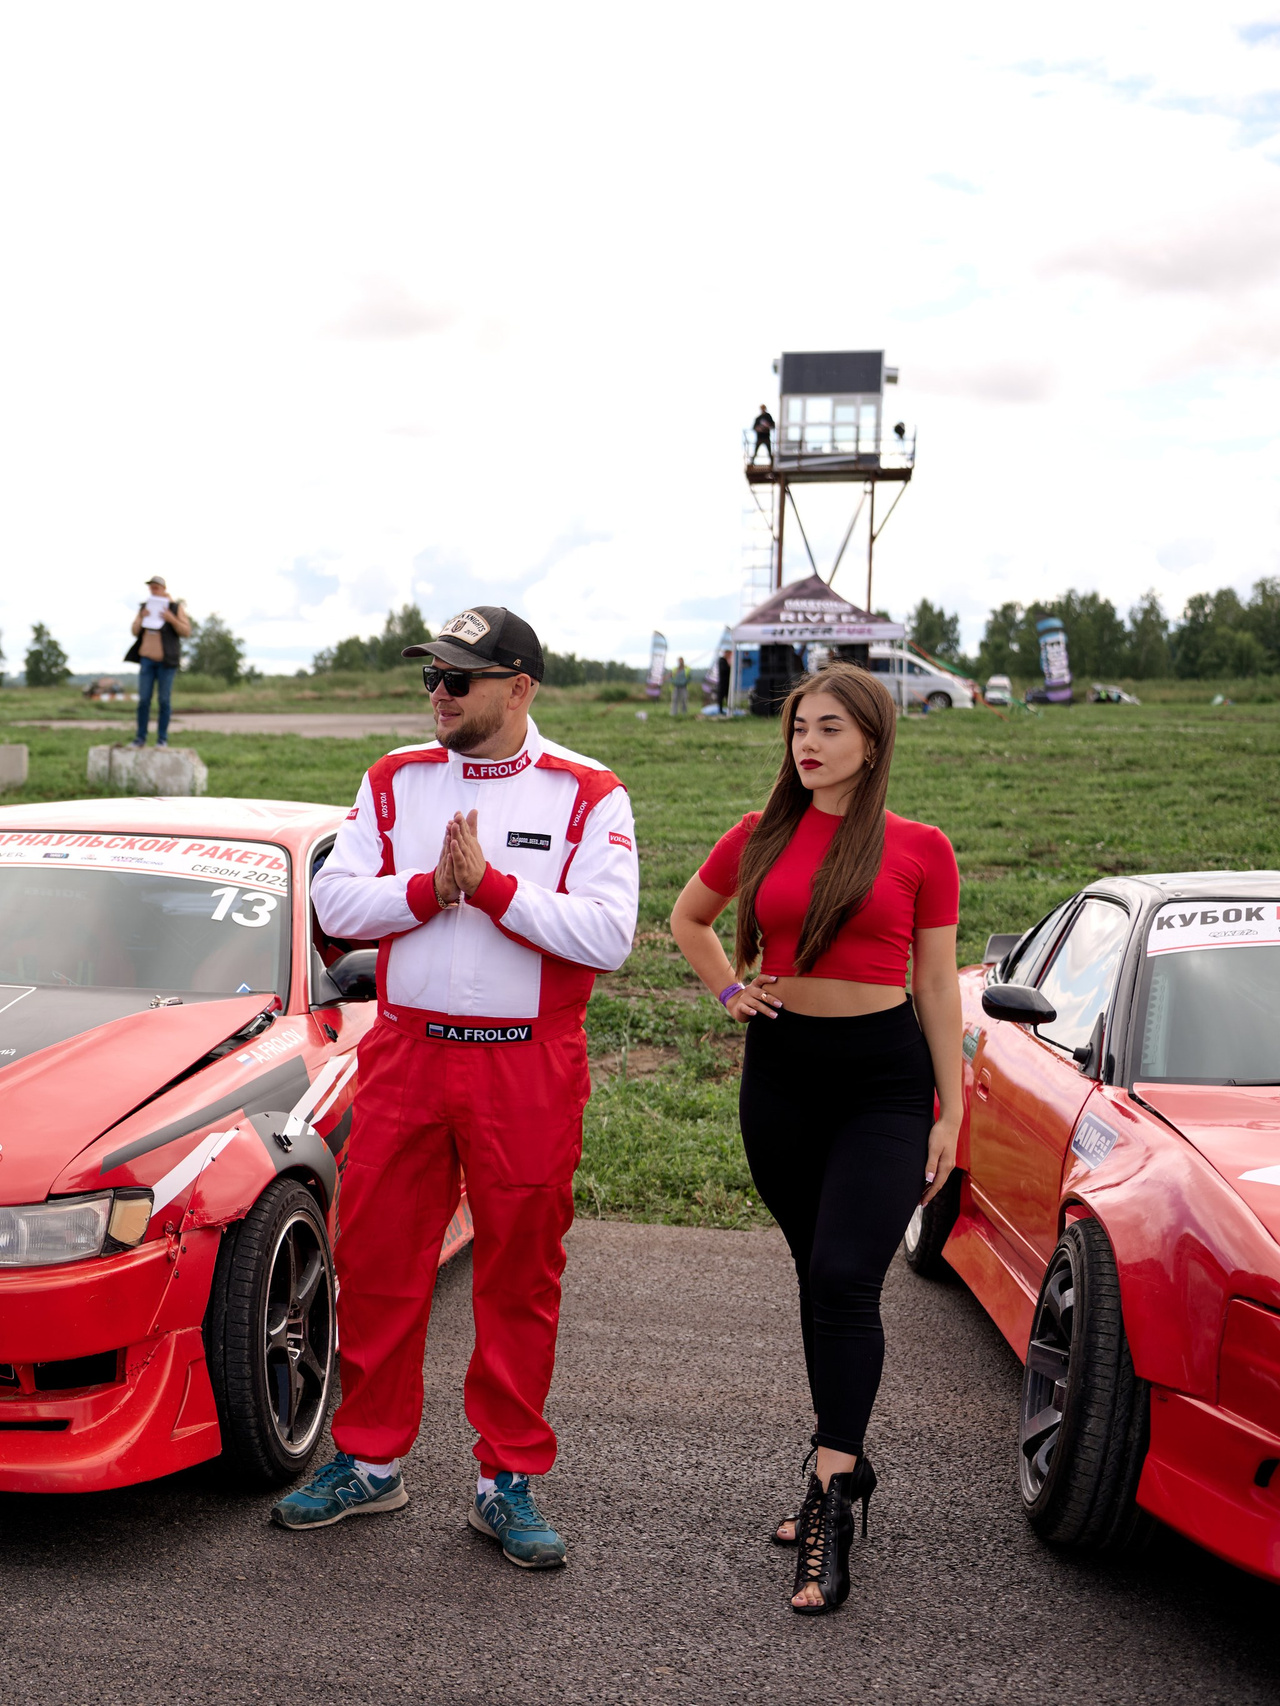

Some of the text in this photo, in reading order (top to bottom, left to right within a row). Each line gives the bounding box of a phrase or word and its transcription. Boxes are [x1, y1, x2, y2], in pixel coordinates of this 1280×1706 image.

[466, 614, 486, 632] KNIGHTS
[466, 753, 528, 778] A.FROLOV
[380, 792, 389, 819] VOLSON
[572, 800, 588, 827] VOLSON
[609, 834, 632, 848] VOLSON
[191, 864, 241, 878] СЕЗОН
[211, 886, 278, 928] 13
[1156, 906, 1265, 931] КУБОК
[249, 1028, 304, 1064] A.FROLOV
[447, 1026, 529, 1041] A.FROLOV
